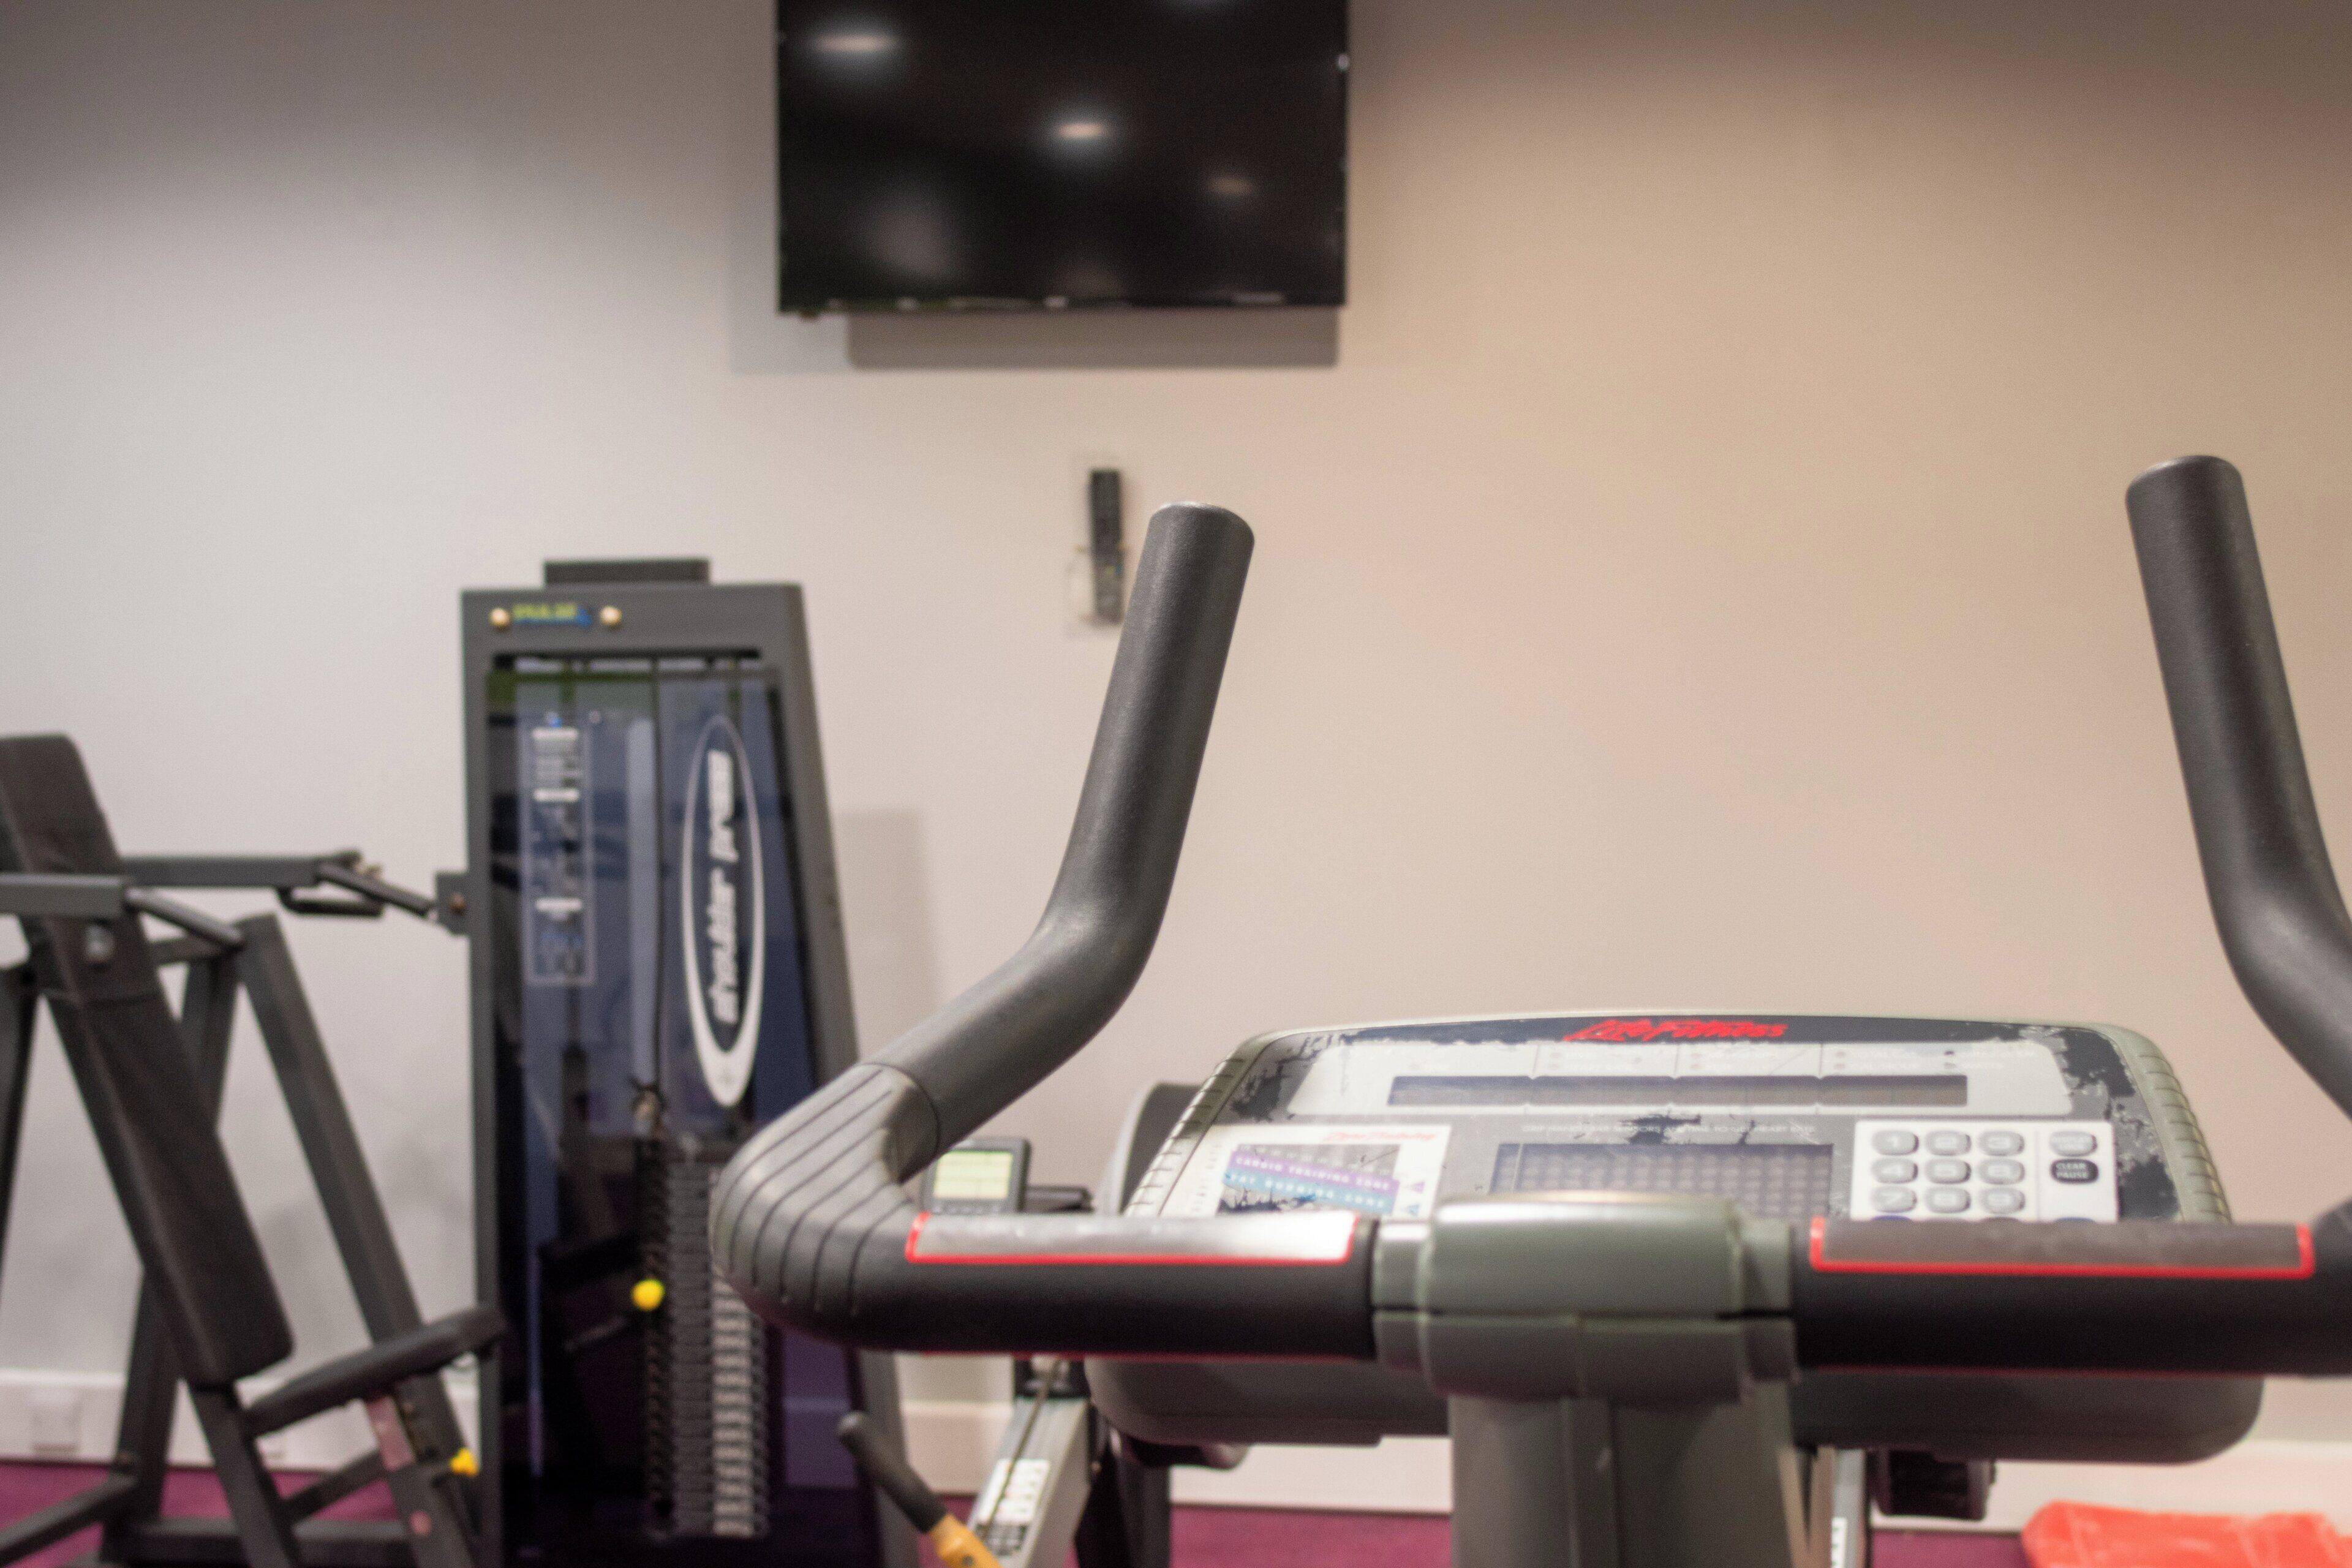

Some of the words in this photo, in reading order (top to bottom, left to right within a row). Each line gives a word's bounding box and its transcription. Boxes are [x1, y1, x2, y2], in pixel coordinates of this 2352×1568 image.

[1987, 1137, 2011, 1149] 3
[1236, 1157, 1284, 1172] CARDIO
[1288, 1166, 1349, 1183] TRAINING
[1355, 1177, 1389, 1190] ZONE
[1880, 1165, 1904, 1177] 4
[1230, 1173, 1255, 1185] FAT
[1265, 1178, 1333, 1199] BURNING
[1344, 1194, 1384, 1208] ZONE
